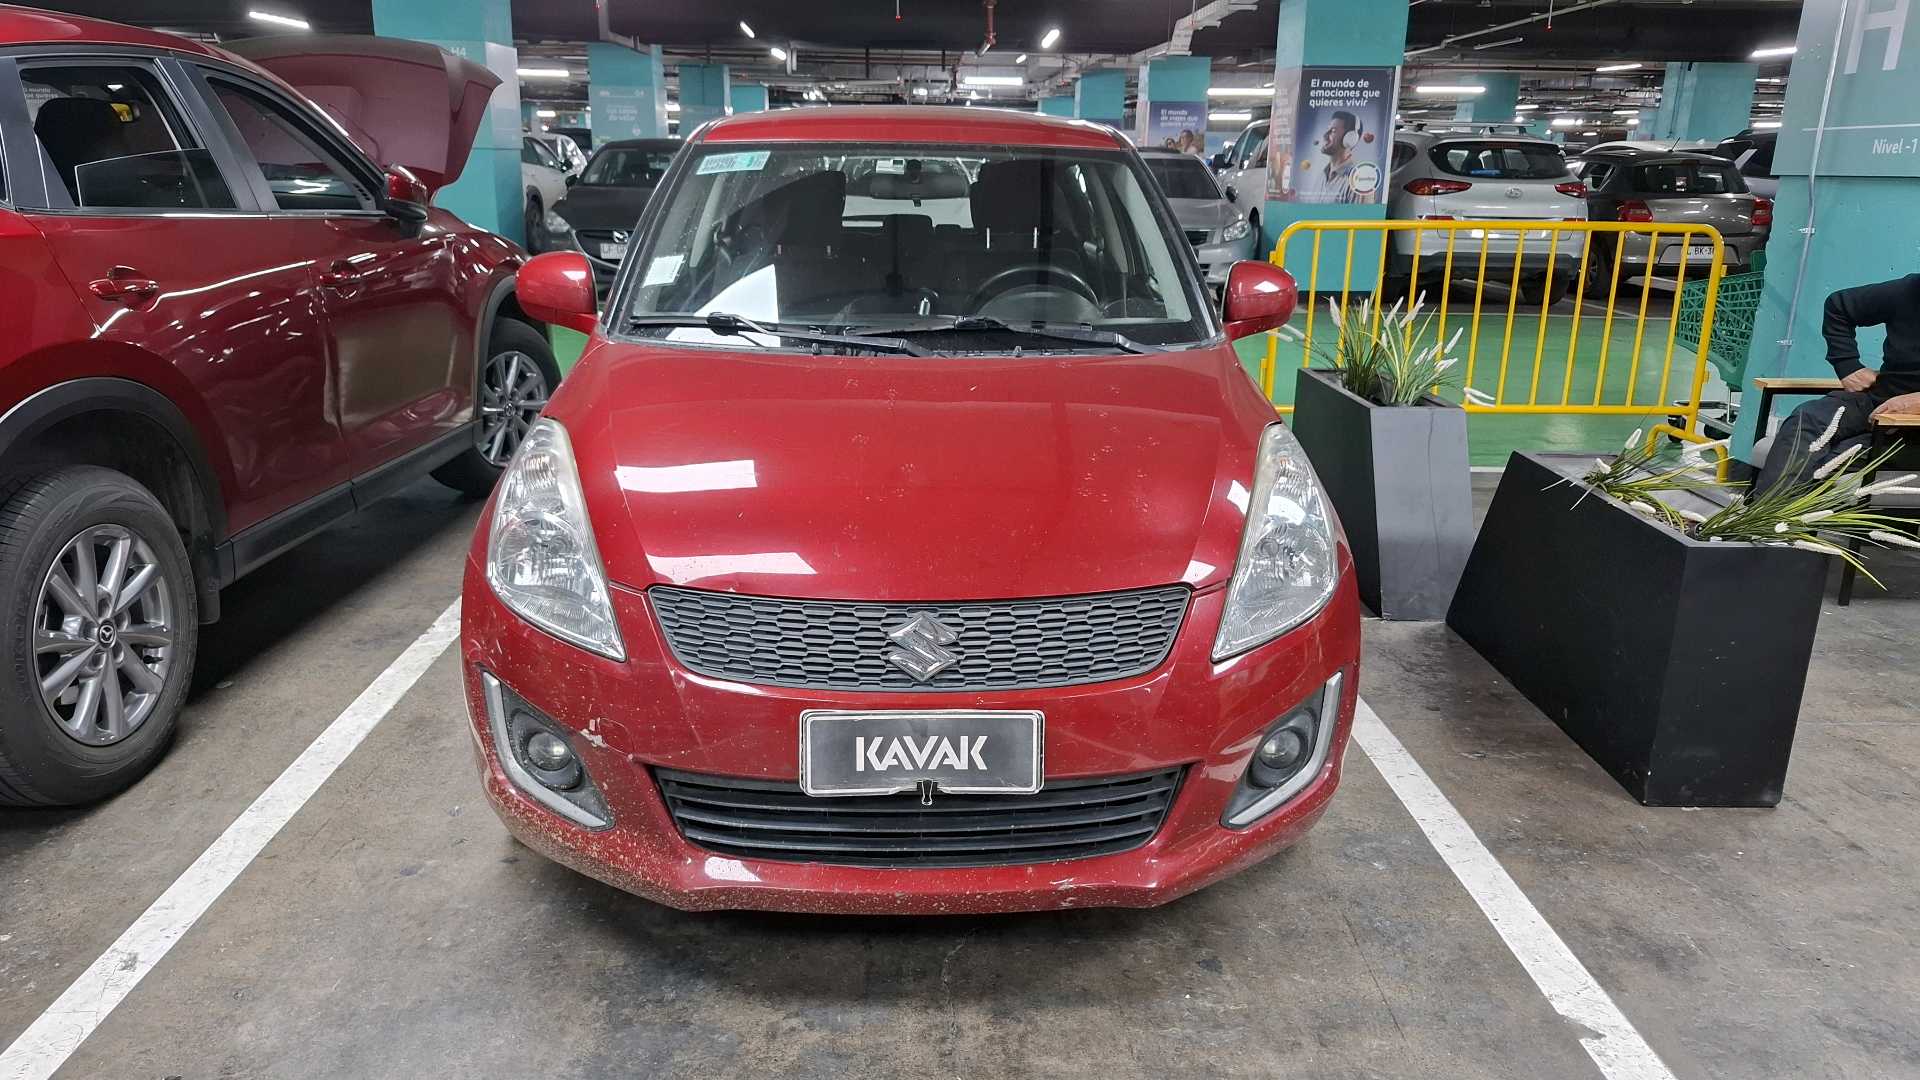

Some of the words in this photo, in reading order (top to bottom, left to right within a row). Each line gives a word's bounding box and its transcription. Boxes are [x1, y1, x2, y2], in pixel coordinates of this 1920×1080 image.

[1310, 78, 1320, 89] El
[1322, 78, 1355, 89] mundo
[1357, 78, 1370, 89] de
[1309, 88, 1361, 98] emociones
[1362, 89, 1381, 100] que
[1308, 98, 1344, 109] quieres
[1345, 98, 1369, 107] vivir
[1872, 138, 1904, 154] Nivel
[1905, 138, 1918, 153] -1
[855, 735, 988, 771] KAVAK
